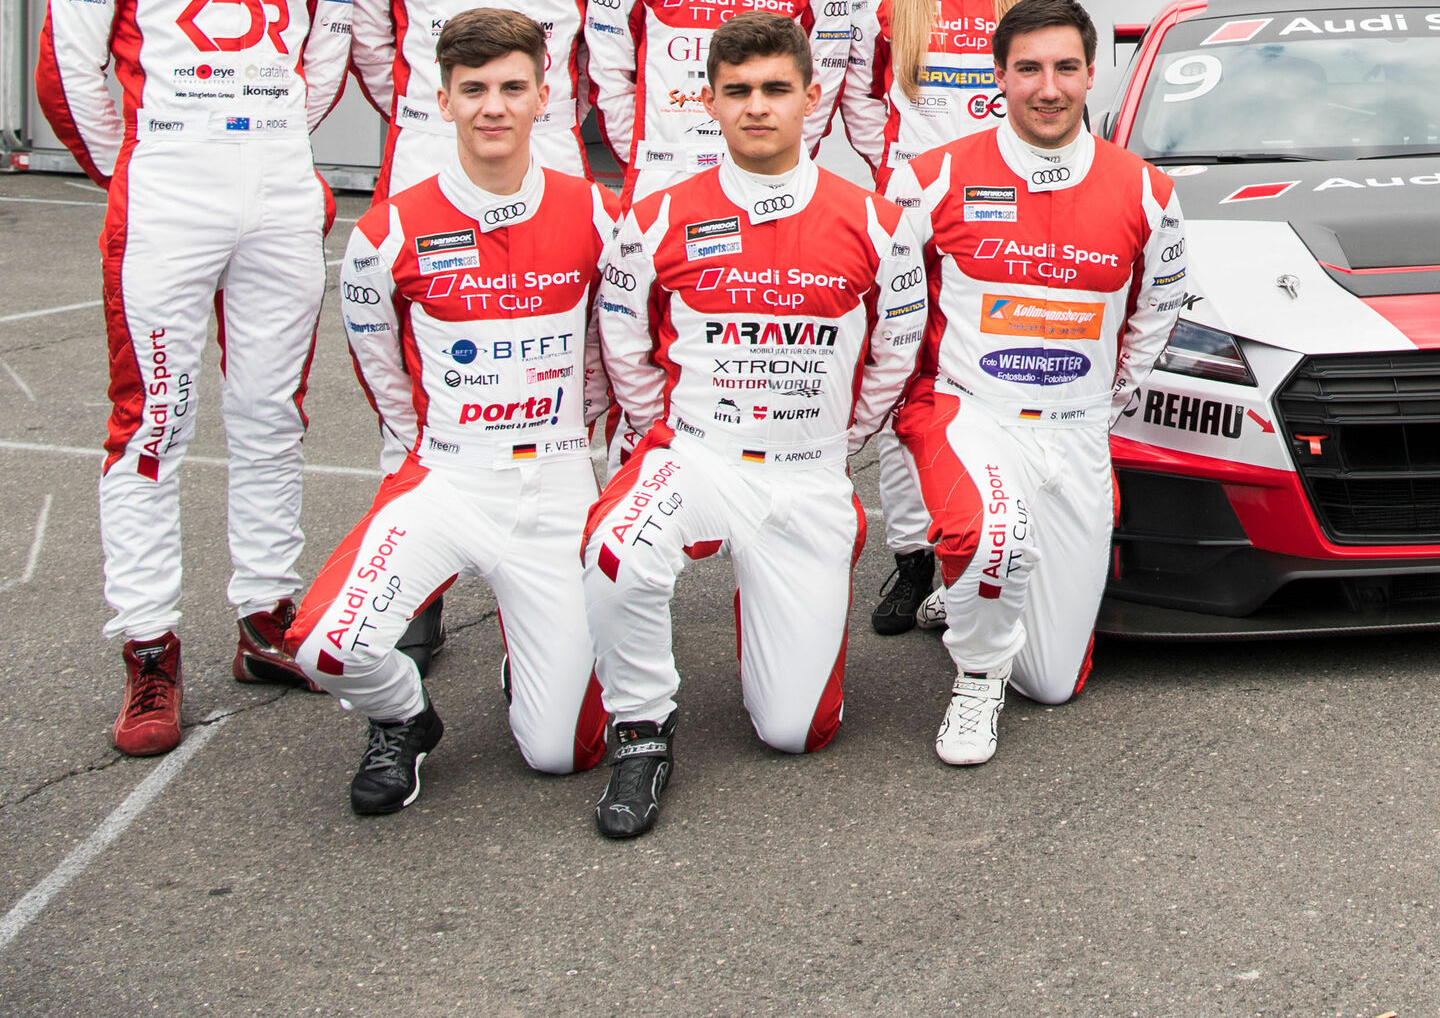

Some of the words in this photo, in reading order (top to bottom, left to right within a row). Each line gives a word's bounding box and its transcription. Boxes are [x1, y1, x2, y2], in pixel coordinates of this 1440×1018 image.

[689, 6, 715, 21] TT
[1278, 14, 1408, 35] Audi
[954, 34, 988, 50] Cup
[821, 57, 847, 69] REHAU
[174, 66, 195, 76] red
[213, 67, 235, 79] eye
[918, 71, 996, 84] RAVENO
[1162, 55, 1223, 103] 9
[243, 85, 289, 99] ikonsigns
[149, 118, 184, 132] freem
[256, 120, 264, 129] D.
[267, 119, 288, 129] RIDGE
[646, 150, 673, 162] freem
[975, 209, 1015, 220] sportscars
[697, 241, 741, 257] sportscars
[1004, 240, 1056, 258] Audi
[1062, 244, 1119, 268] Sport
[432, 256, 477, 270] sportscars
[1004, 260, 1033, 275] TT
[1037, 262, 1077, 283] Cup
[459, 273, 517, 290] Audi
[524, 270, 581, 290] Sport
[726, 267, 780, 286] Audi
[787, 268, 847, 290] Sport
[460, 294, 491, 311] TT
[499, 295, 543, 312] Cup
[726, 288, 756, 304] TT
[763, 288, 805, 310] Cup
[706, 321, 839, 347] PARAVAN
[893, 330, 922, 347] REHAU
[493, 333, 573, 360] BFFT
[150, 328, 171, 395] Sport
[713, 359, 827, 374] XTRONIC
[982, 358, 998, 366] Foto
[999, 354, 1082, 372] WEINRETTER
[465, 374, 499, 385] HALTI
[713, 377, 821, 390] MOTORWORLD
[174, 373, 192, 417] Cup
[459, 386, 563, 425] porta!
[773, 408, 820, 420] WÜRTH
[1061, 410, 1085, 419] WIRTH
[1143, 389, 1244, 439] REHAU
[144, 404, 168, 456] Audi
[429, 438, 460, 454] freem
[545, 443, 553, 453] F.
[556, 438, 588, 452] VETTEL
[775, 454, 783, 462] K.
[785, 450, 822, 462] ARNOLD
[985, 463, 1010, 515] Sport
[611, 491, 653, 544] Audi
[642, 461, 681, 491] Sport
[657, 492, 683, 517] Cup
[1013, 499, 1029, 541] Cup
[982, 524, 1007, 579] Audi
[326, 586, 368, 650] Audi
[357, 526, 407, 582] Sport
[372, 575, 402, 613] Cup
